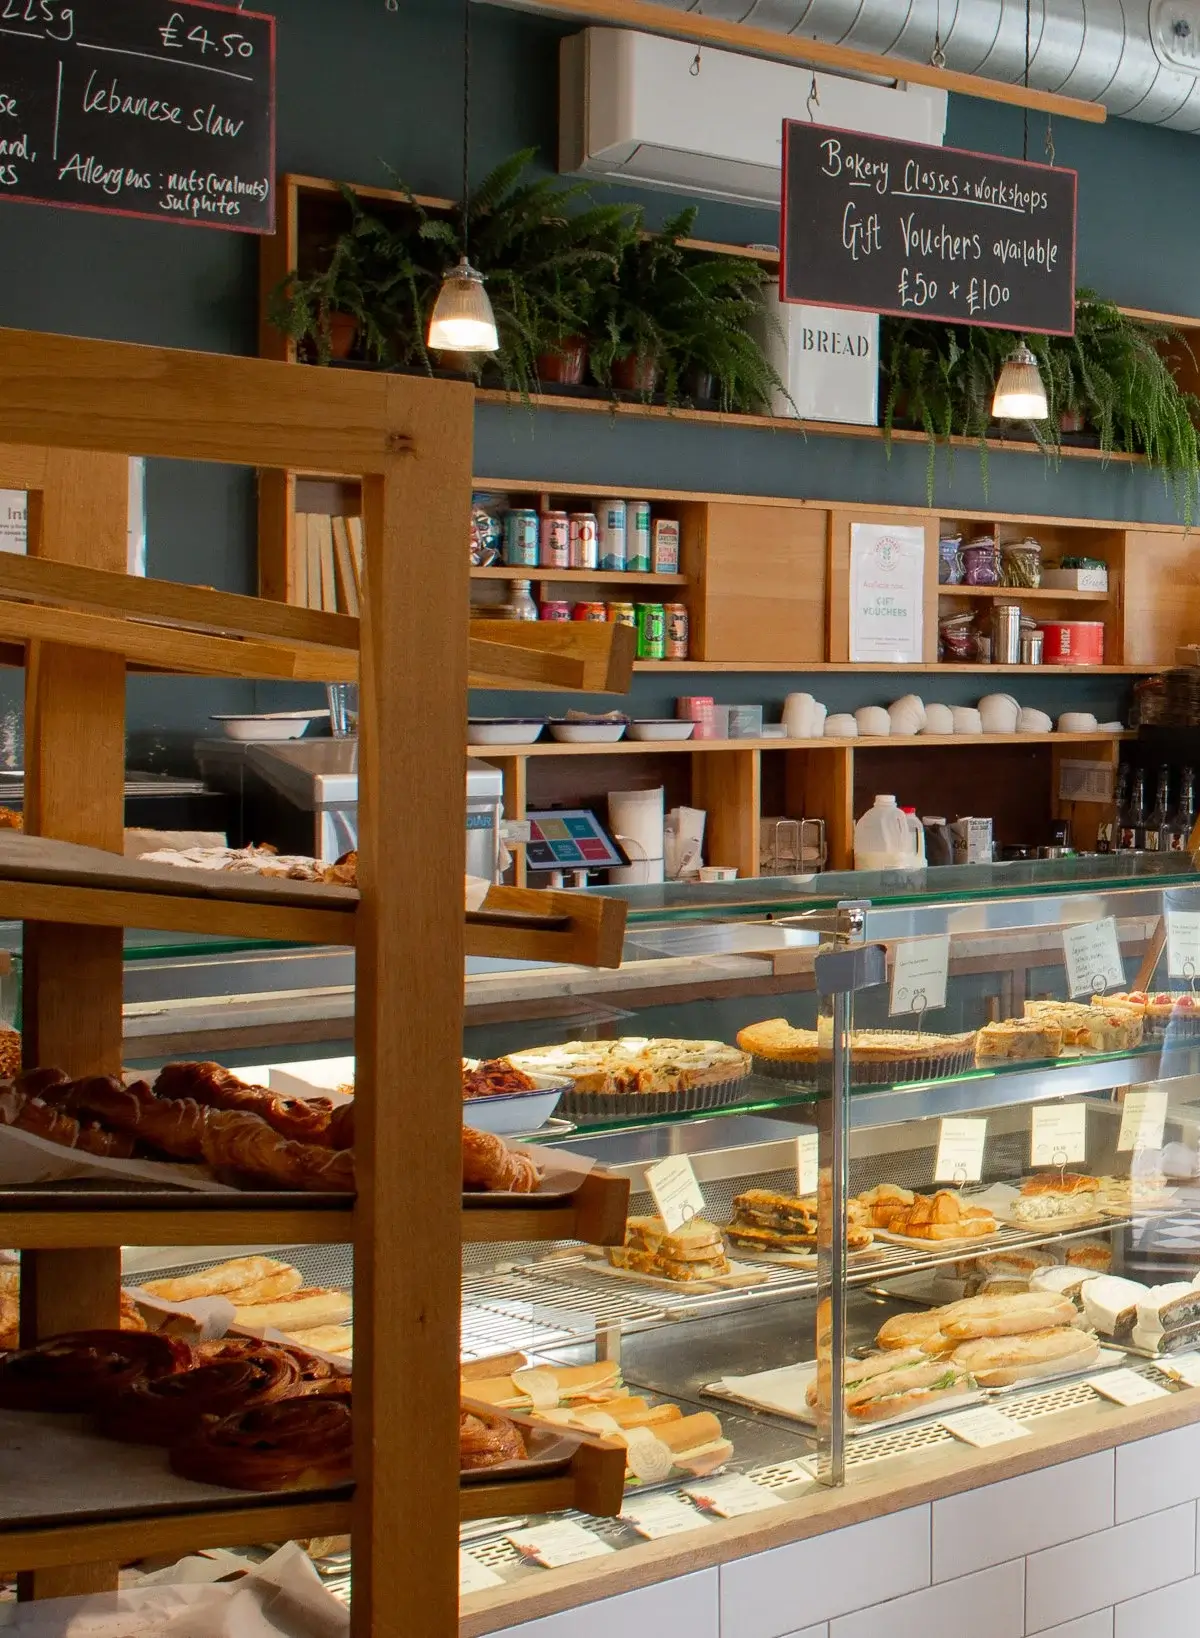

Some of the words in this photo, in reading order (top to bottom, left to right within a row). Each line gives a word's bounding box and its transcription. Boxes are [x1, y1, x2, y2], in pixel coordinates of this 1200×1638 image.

[159, 13, 253, 57] £4.50
[821, 139, 888, 194] Bakery
[904, 160, 959, 196] Classes
[843, 202, 881, 260] Gift
[993, 238, 1057, 272] available
[898, 268, 937, 307] £50
[967, 278, 1010, 315] £100
[802, 328, 869, 357] BREAD
